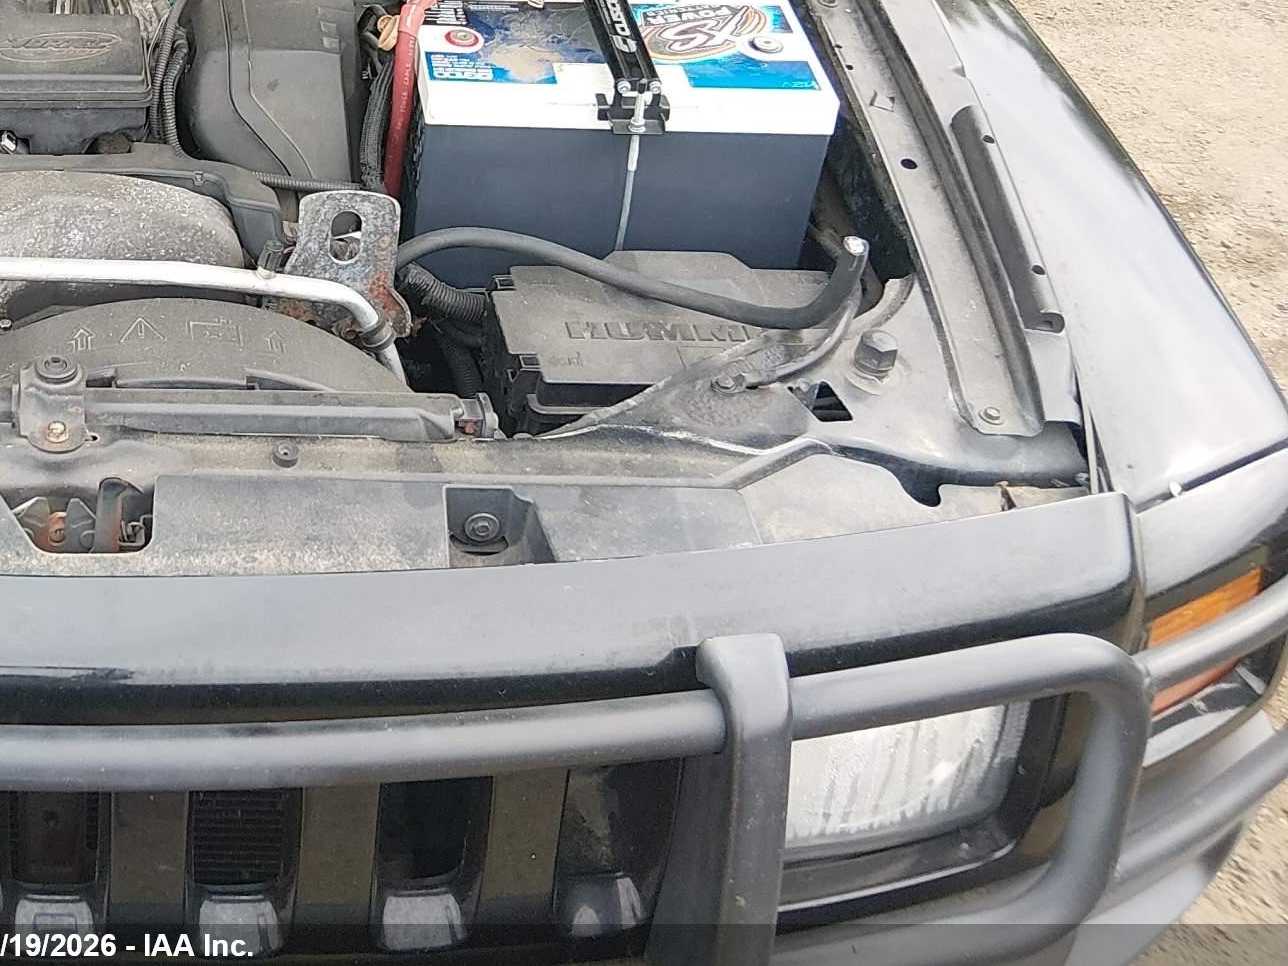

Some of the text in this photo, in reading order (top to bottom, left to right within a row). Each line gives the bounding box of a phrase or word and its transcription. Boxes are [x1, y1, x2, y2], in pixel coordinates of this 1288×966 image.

[647, 6, 731, 25] POWER
[661, 5, 748, 51] XS
[564, 321, 760, 343] HUMM
